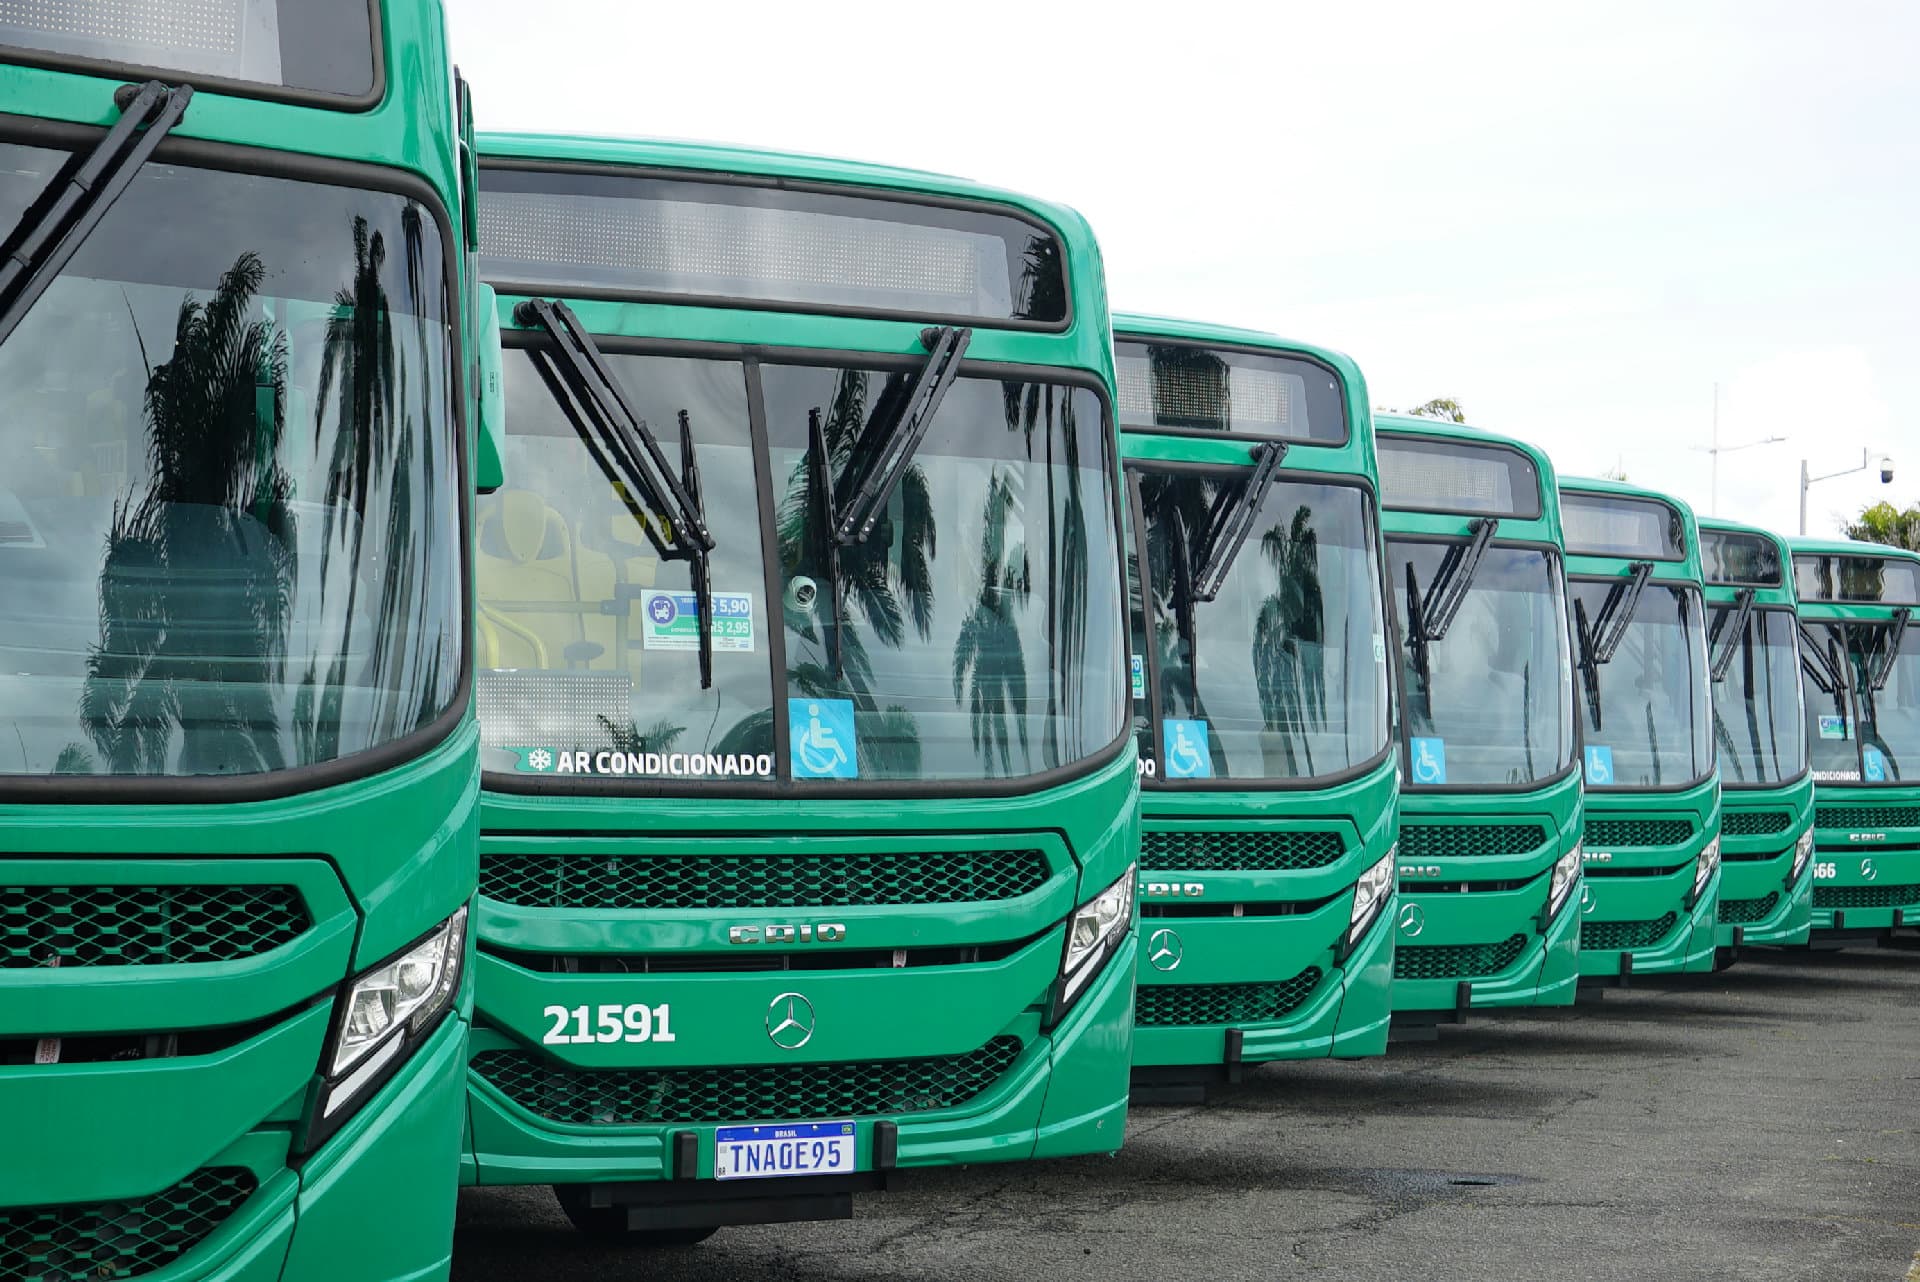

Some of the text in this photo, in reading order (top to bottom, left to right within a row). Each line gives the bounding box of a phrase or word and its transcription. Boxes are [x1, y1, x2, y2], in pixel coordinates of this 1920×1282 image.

[719, 599, 749, 615] 5,90
[726, 621, 749, 635] 2,95
[556, 751, 771, 776] AR CONDICIONADO
[1811, 770, 1861, 781] ONDICIONADO
[1399, 866, 1440, 877] AIO
[1140, 883, 1204, 896] AIO
[729, 924, 846, 944] CAIO
[543, 1004, 675, 1045] 21591
[774, 1129, 797, 1138] BRASIL
